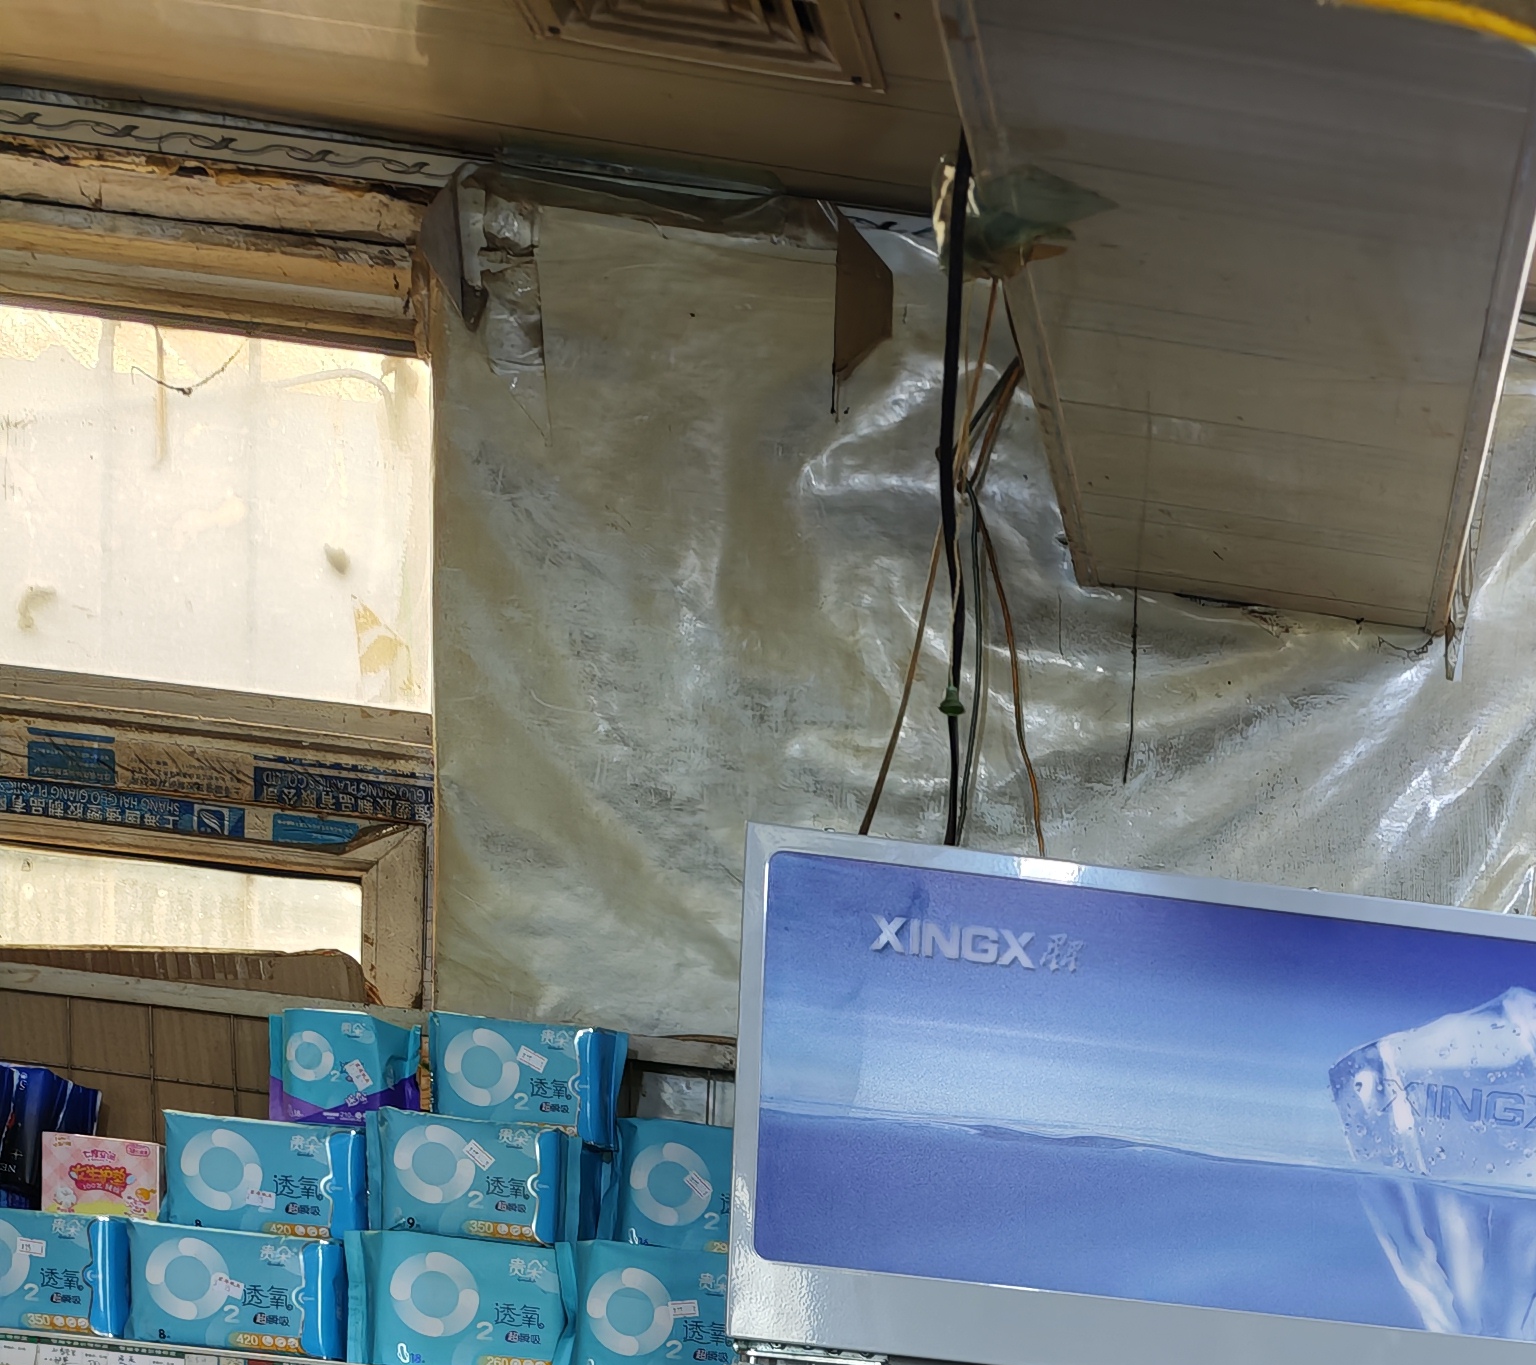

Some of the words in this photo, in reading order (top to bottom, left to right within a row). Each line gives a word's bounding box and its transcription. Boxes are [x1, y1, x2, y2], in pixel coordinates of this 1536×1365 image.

[870, 914, 1036, 970] XINGX
[529, 1077, 571, 1100] 透氧
[273, 1175, 323, 1201] 透氧
[485, 1176, 529, 1200] 透氧
[270, 1224, 291, 1236] 420
[469, 1220, 493, 1233] 350
[40, 1267, 84, 1291] 透氧
[242, 1285, 293, 1311] 透氧
[27, 1313, 50, 1326] 350
[494, 1303, 543, 1328] 透氧
[236, 1334, 258, 1346] 420
